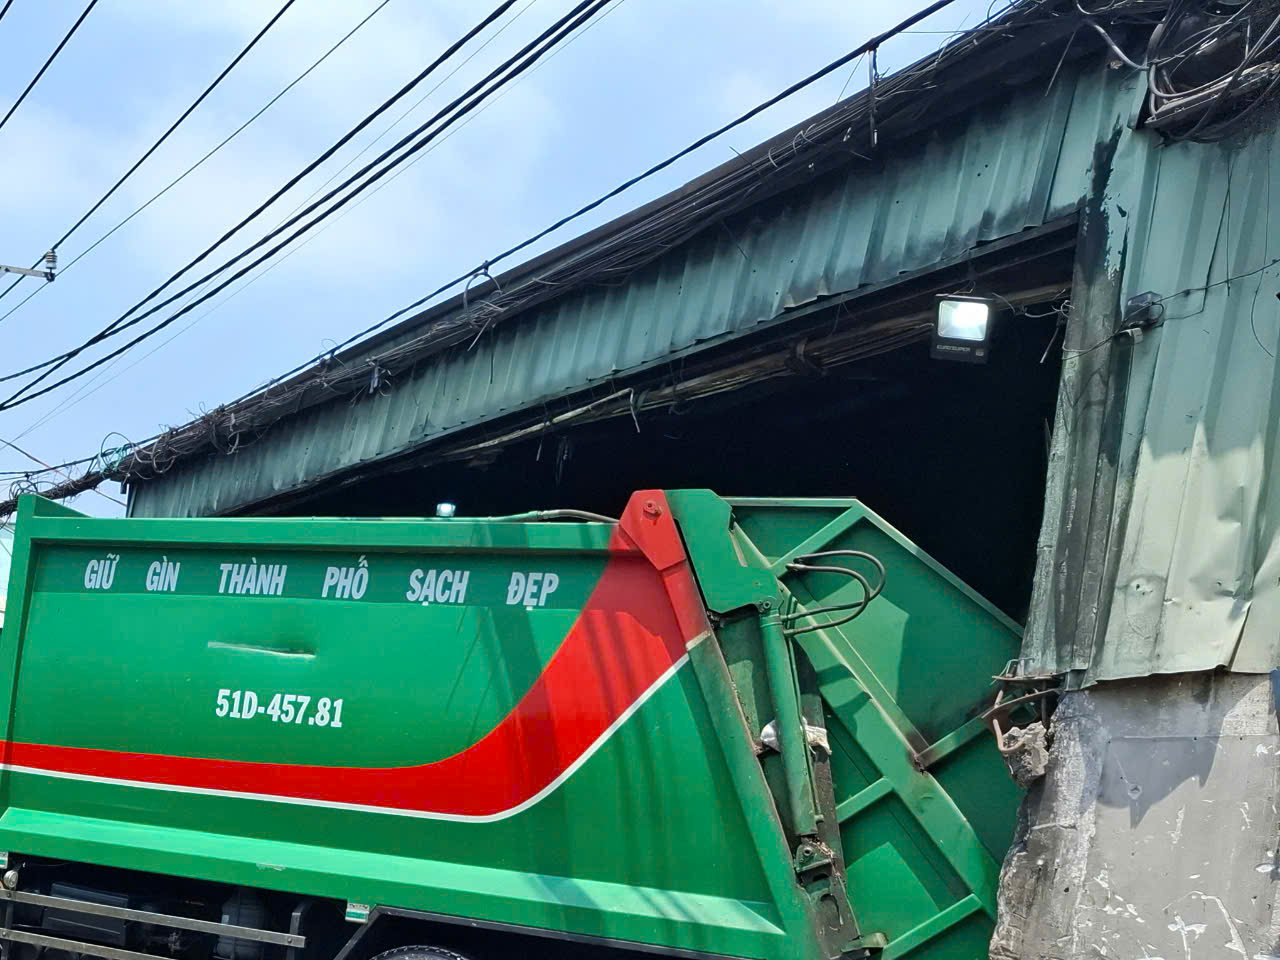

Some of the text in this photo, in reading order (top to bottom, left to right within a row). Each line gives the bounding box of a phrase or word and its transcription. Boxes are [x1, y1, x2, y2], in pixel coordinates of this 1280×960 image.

[84, 553, 560, 611] GIỮ GÌN THÀNH PHỐ SẠCH ĐẸP
[215, 688, 343, 728] 51D-457.81
